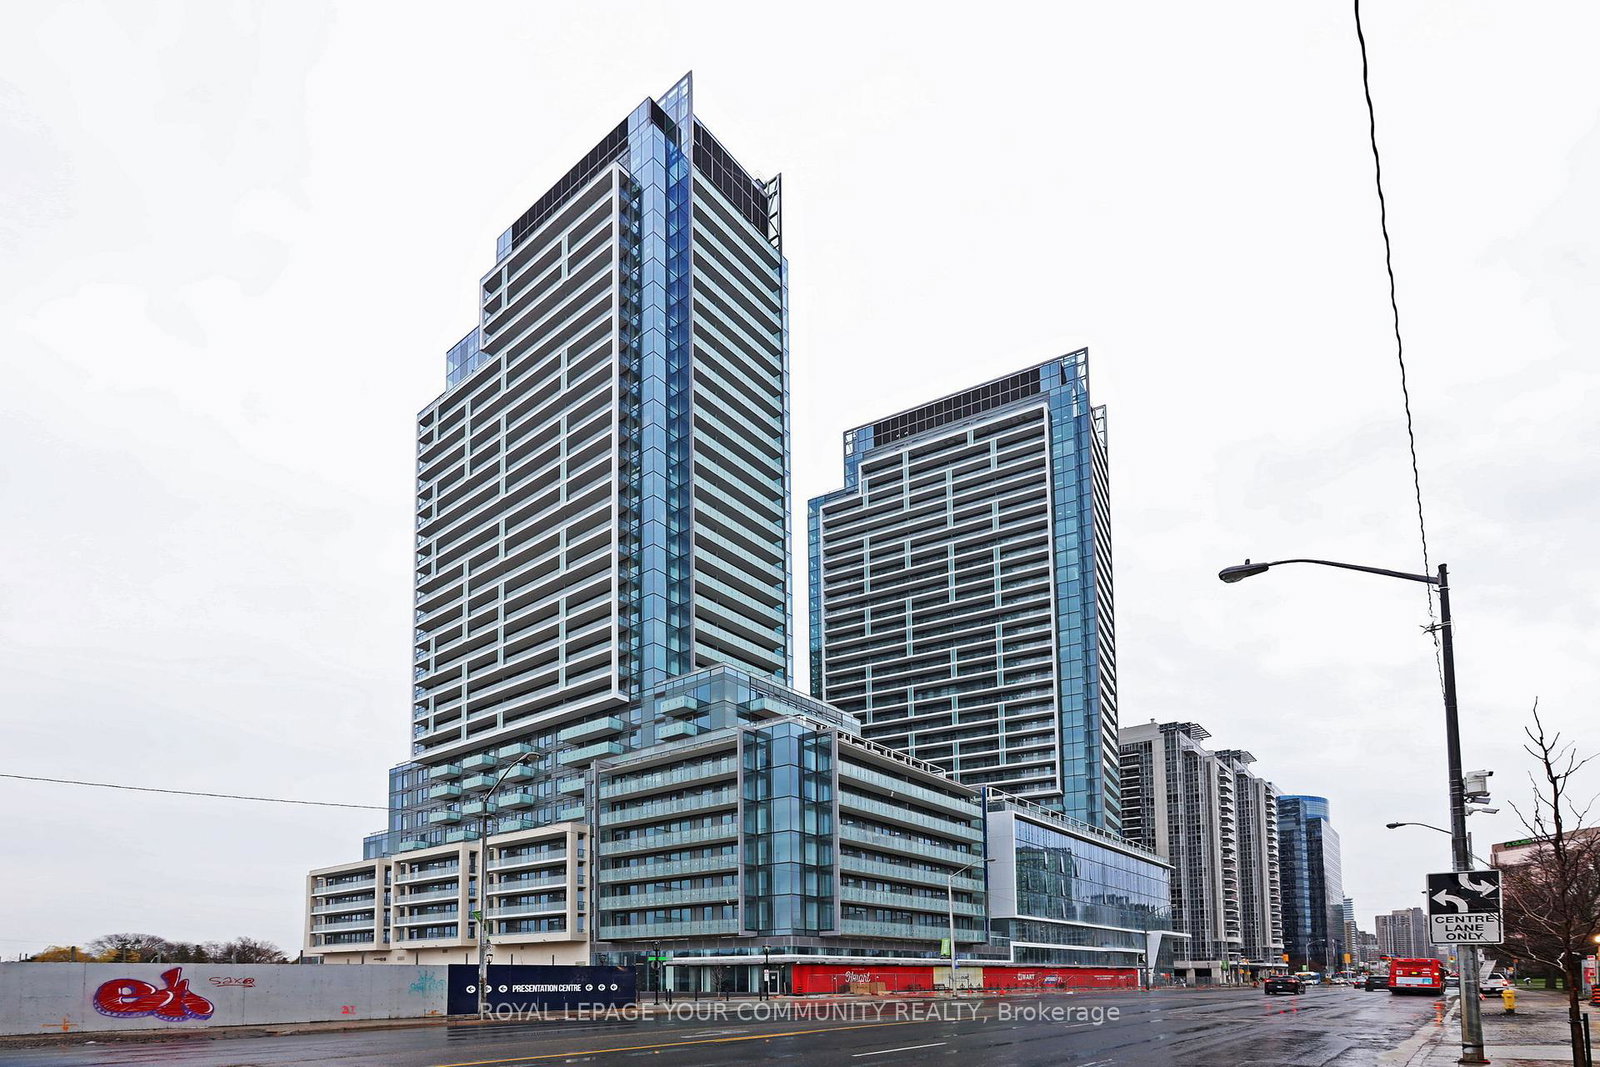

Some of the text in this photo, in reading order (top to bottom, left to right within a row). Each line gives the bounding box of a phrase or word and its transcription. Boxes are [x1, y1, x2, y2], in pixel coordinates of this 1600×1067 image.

[1434, 915, 1494, 924] CENTRE
[1445, 924, 1484, 932] LANE
[1446, 932, 1483, 941] ONLY
[512, 983, 582, 993] PRESENTATION CENTRE
